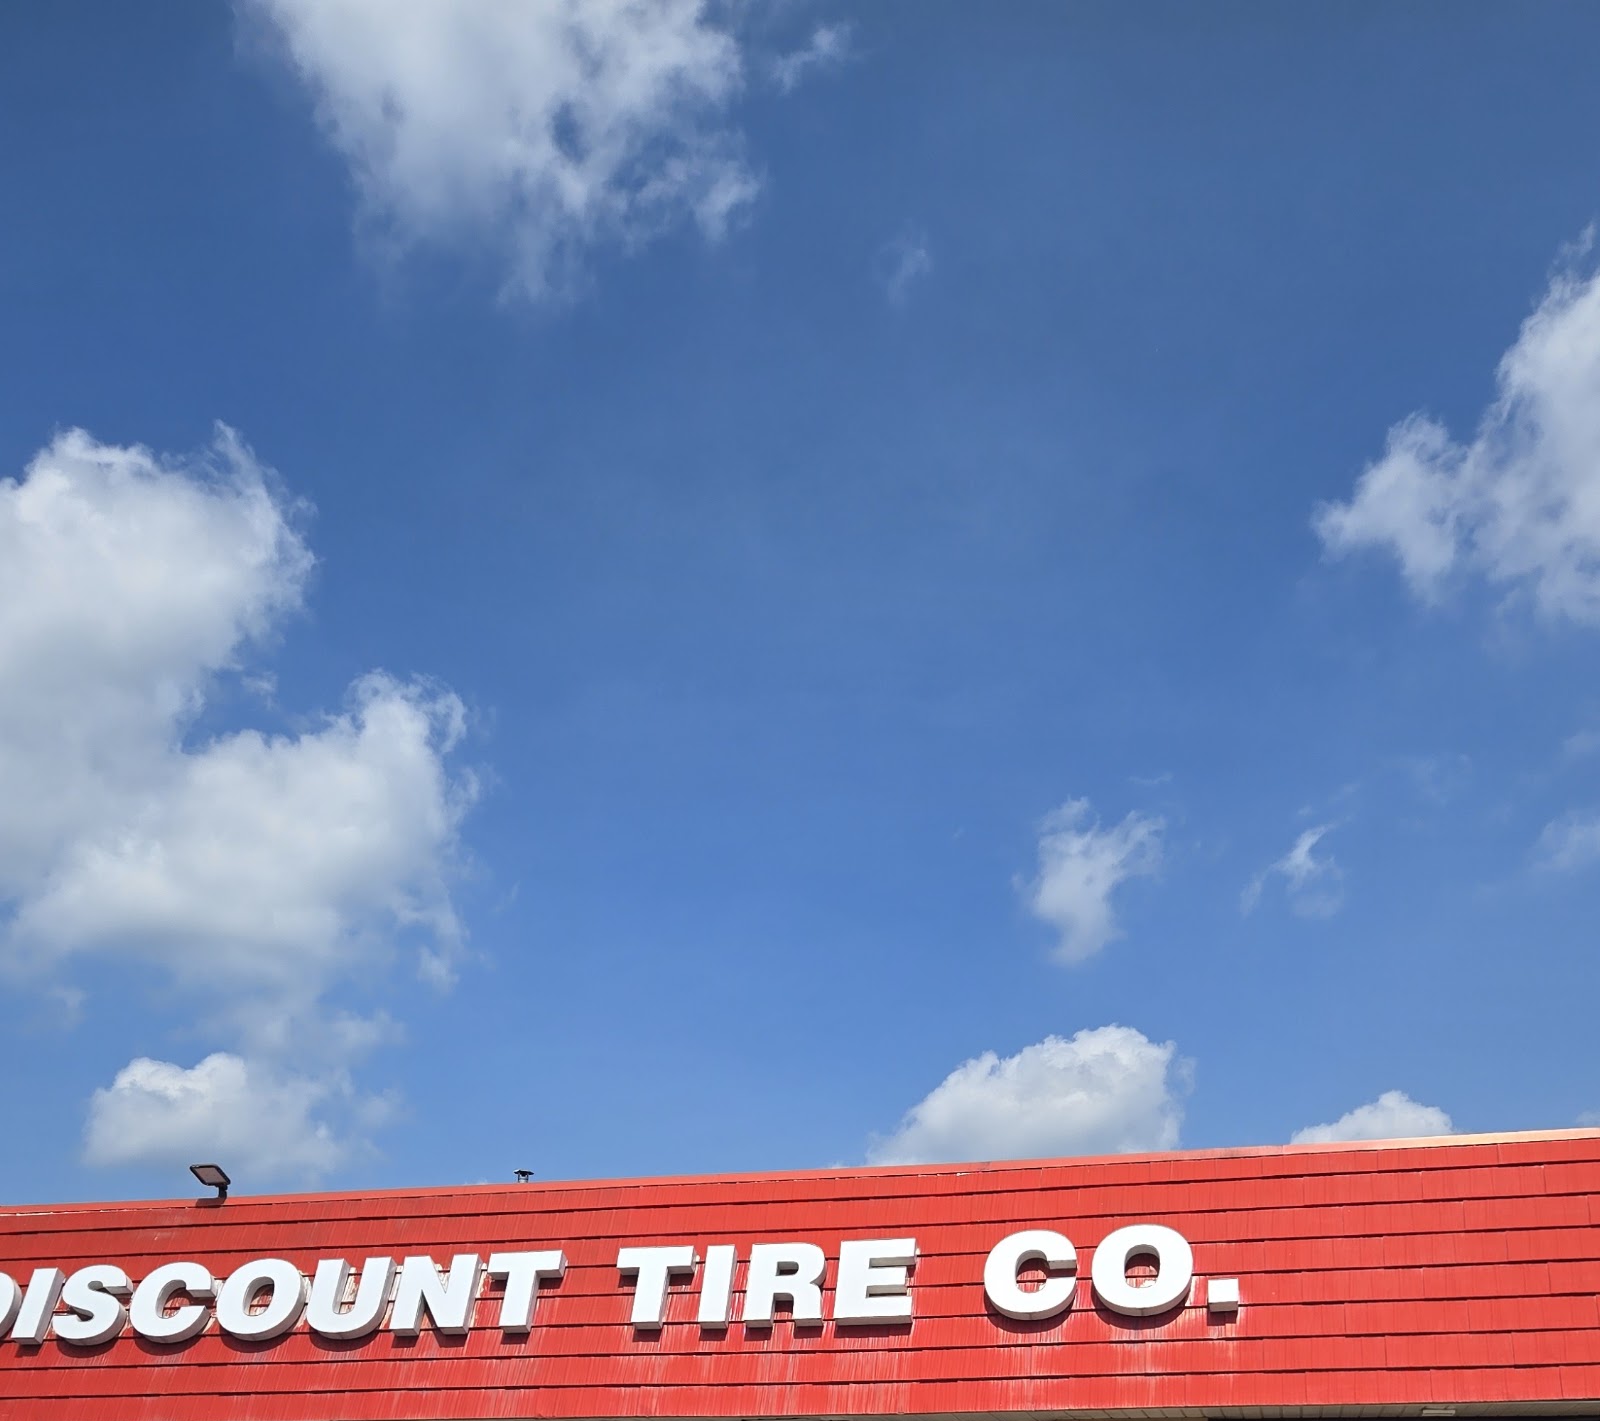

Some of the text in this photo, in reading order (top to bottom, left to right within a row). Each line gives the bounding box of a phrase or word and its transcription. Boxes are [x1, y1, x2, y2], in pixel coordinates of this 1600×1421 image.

[0, 1224, 1239, 1346] ISCOUNT TIRE CO.
